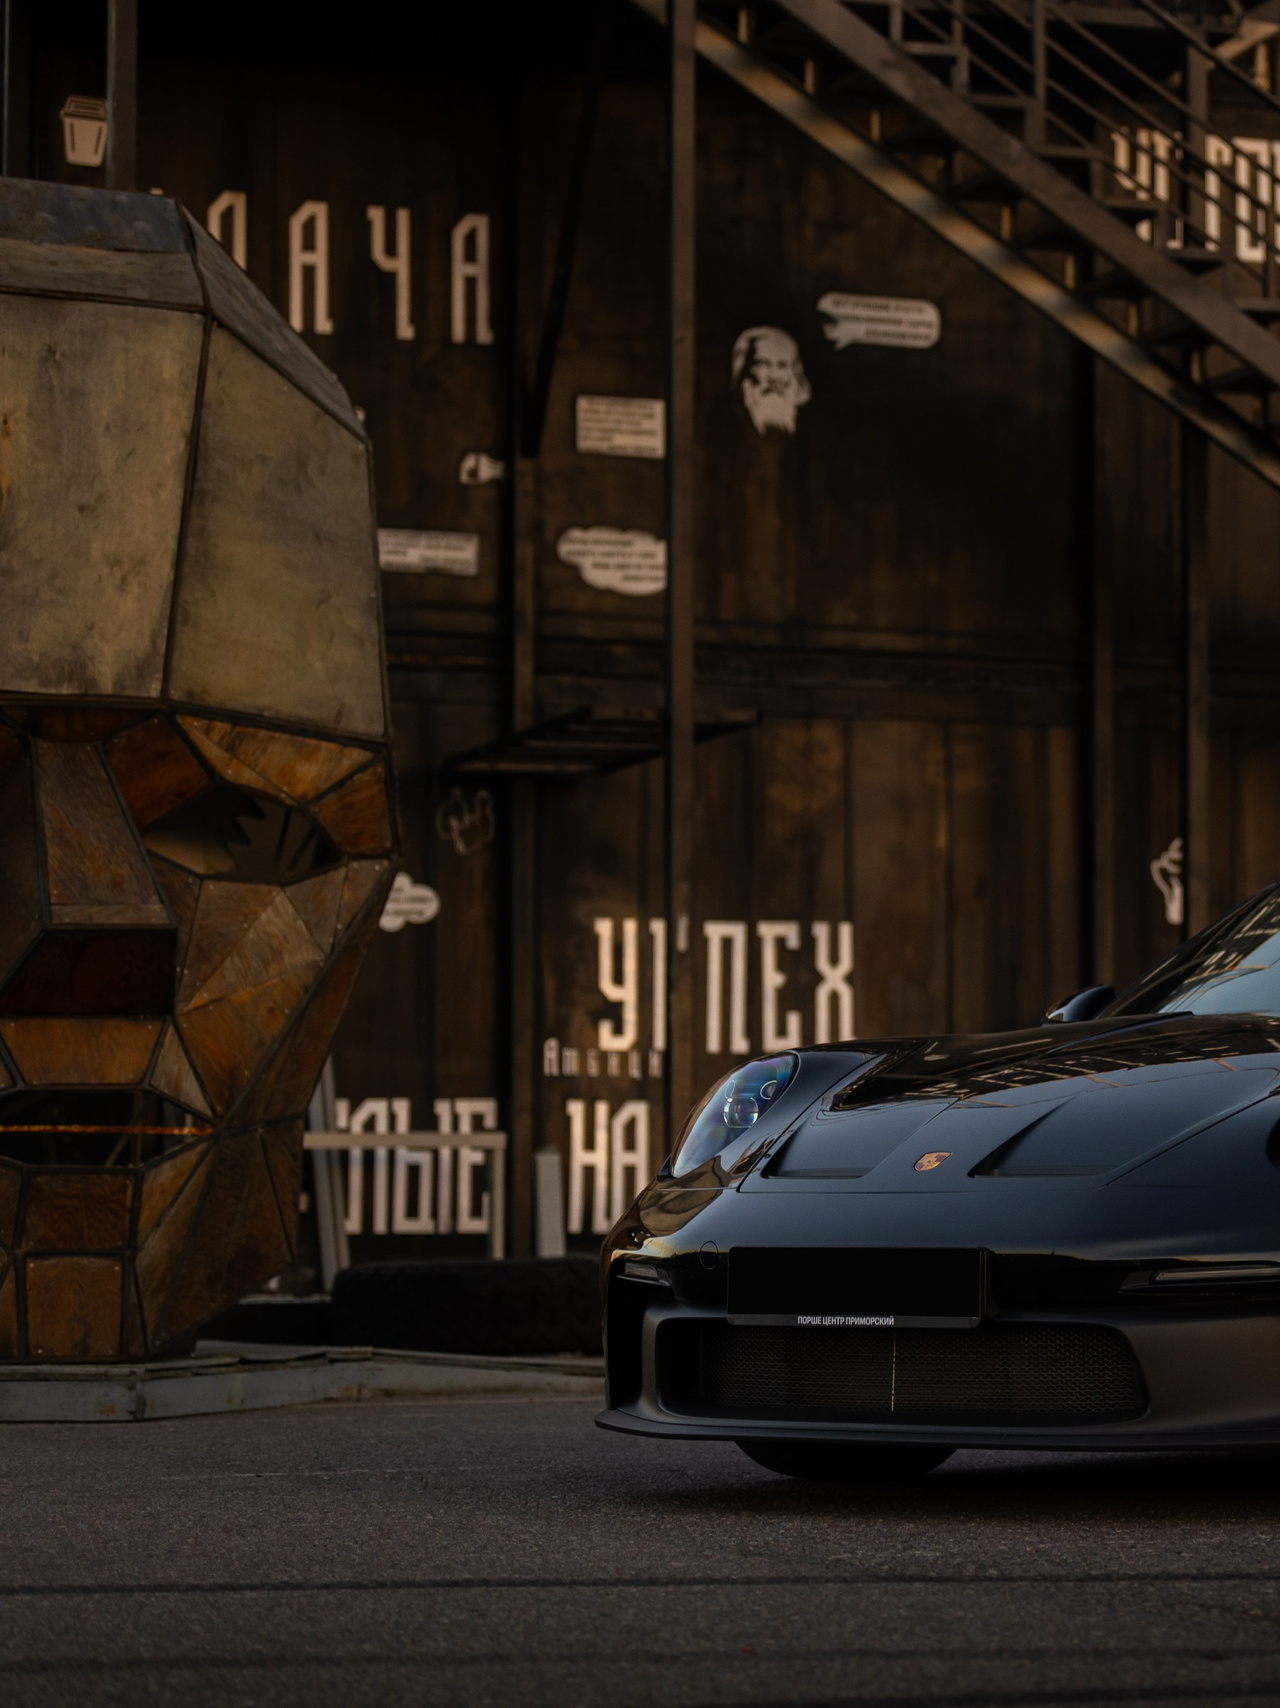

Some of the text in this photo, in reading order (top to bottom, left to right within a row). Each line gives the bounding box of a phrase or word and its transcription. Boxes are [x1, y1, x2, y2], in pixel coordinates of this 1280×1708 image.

[797, 1315, 895, 1326] ПОРШЕ ЦЕНТР ПРИМОРСКИЙ
